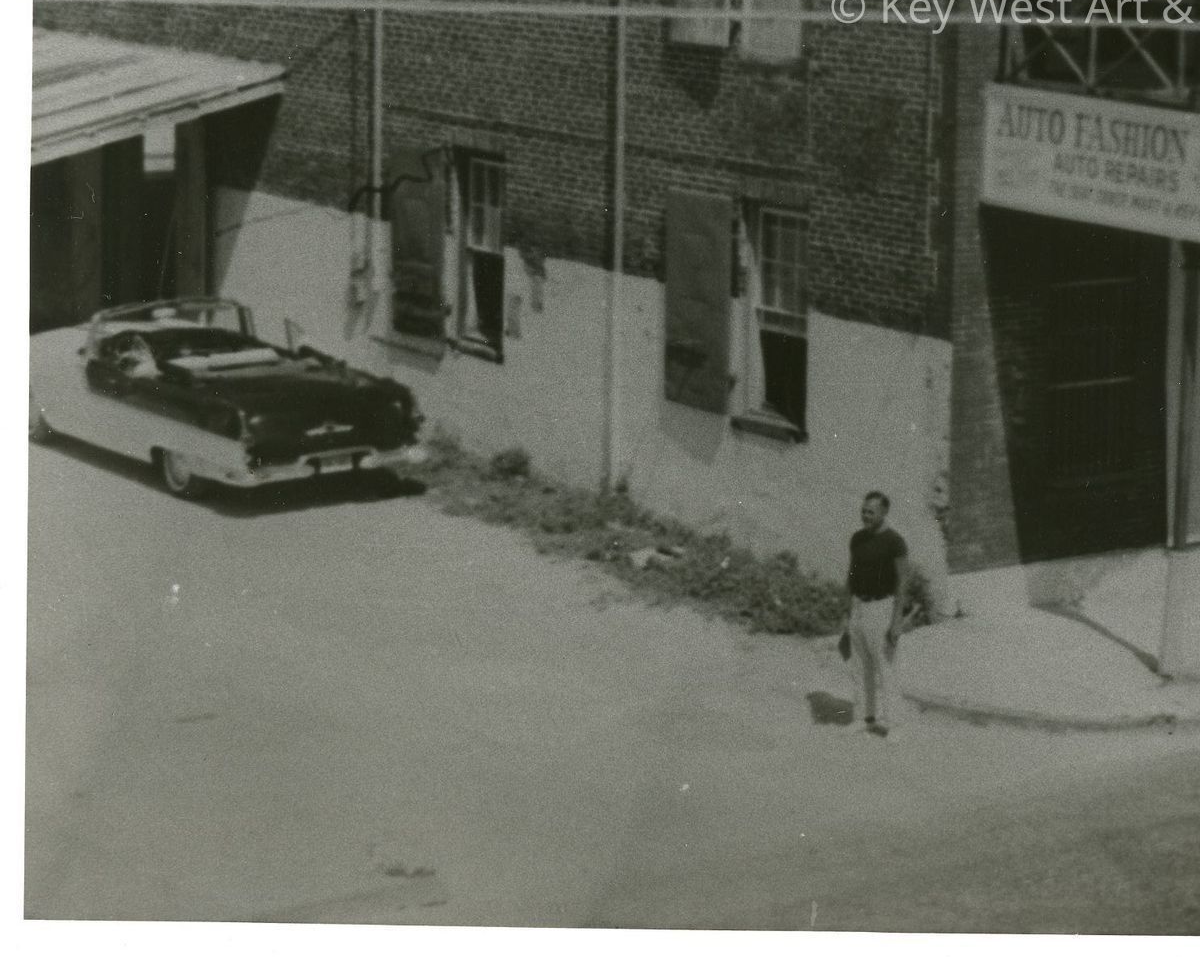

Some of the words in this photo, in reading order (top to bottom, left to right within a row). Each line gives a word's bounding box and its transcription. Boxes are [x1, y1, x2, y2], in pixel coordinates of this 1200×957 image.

[996, 101, 1066, 146] AUTO
[1074, 110, 1190, 164] FASHION
[1053, 153, 1100, 180] AUTO
[1104, 159, 1181, 194] REPAIRS
